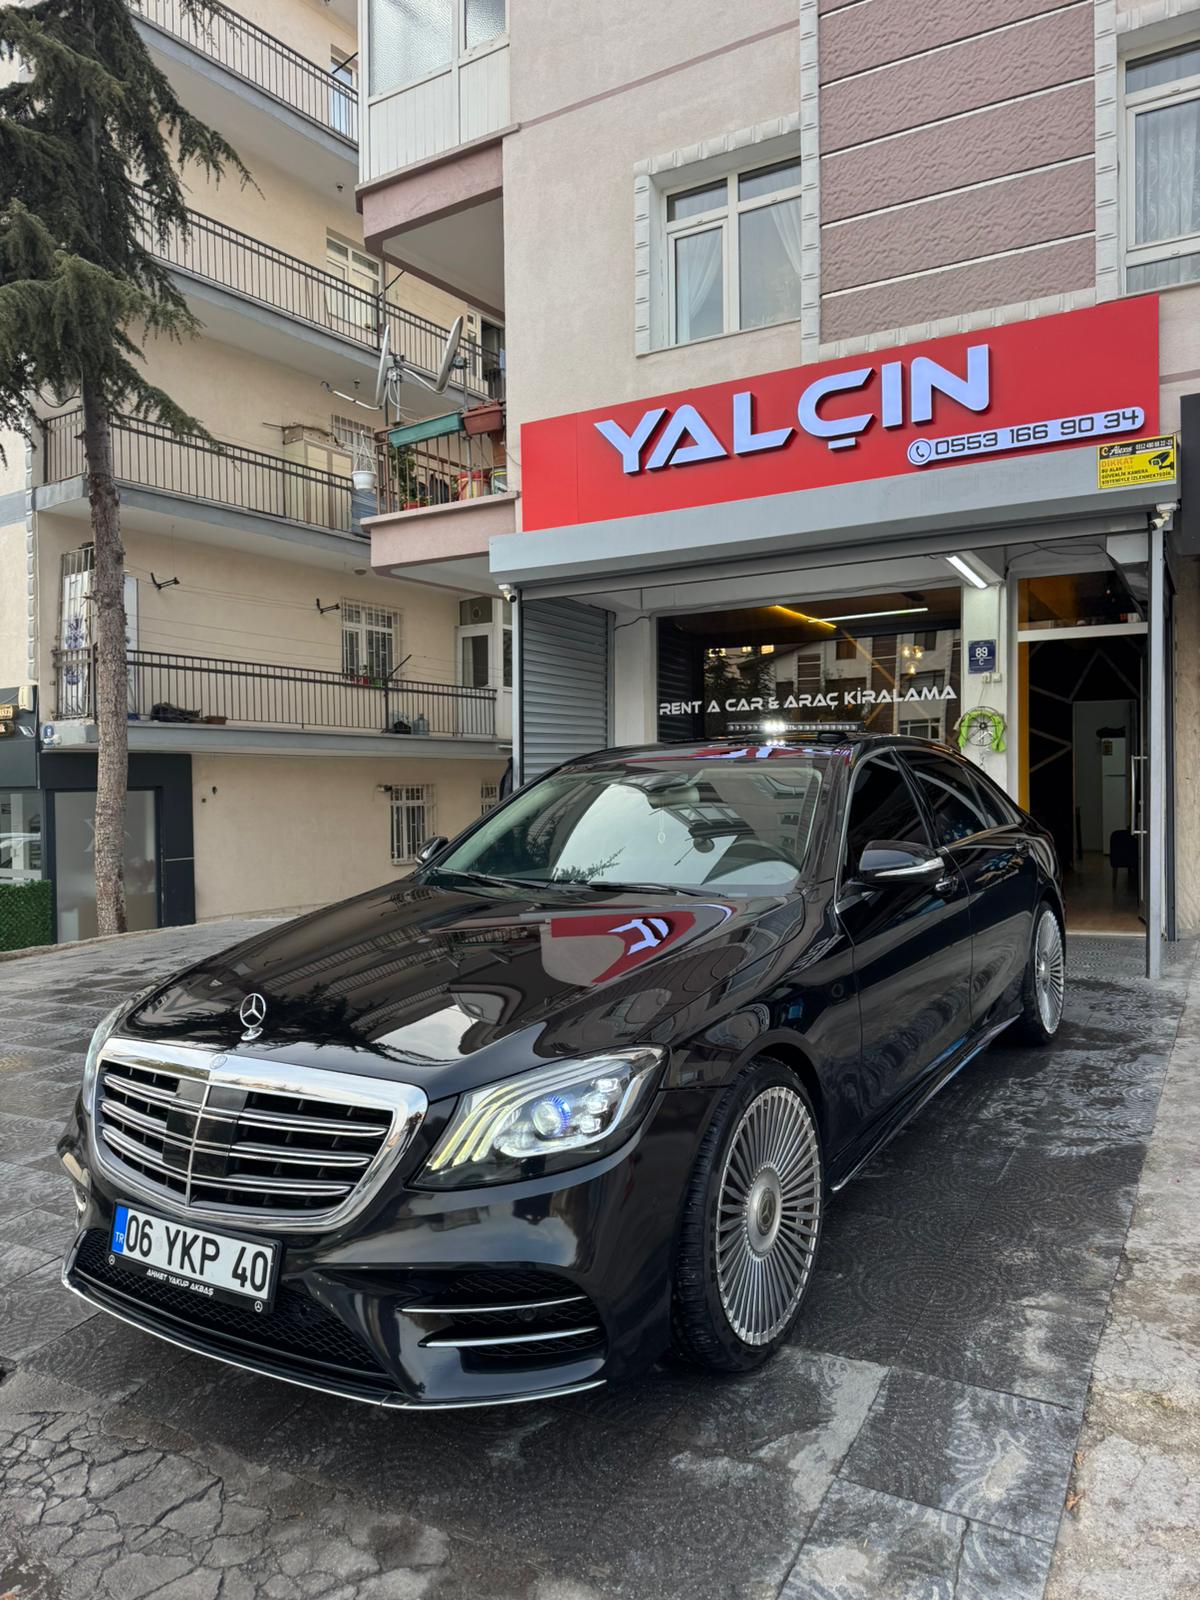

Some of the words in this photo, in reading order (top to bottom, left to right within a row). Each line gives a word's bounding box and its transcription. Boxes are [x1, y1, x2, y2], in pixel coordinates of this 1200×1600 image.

[593, 343, 990, 475] YALÇIN
[935, 432, 998, 456] 0553
[1009, 424, 1048, 443] 166
[1060, 416, 1094, 436] 90
[1104, 409, 1139, 429] 34
[975, 646, 988, 658] 89
[659, 700, 702, 716] RENT
[707, 699, 721, 713] A
[725, 696, 762, 712] CAR
[768, 696, 780, 710] &
[783, 691, 839, 711] ARAÇ
[844, 685, 957, 705] KİRALAMA
[115, 1231, 124, 1245] TR
[125, 1214, 154, 1258] 06
[165, 1225, 220, 1276] YKP
[231, 1246, 269, 1292] 40
[146, 1269, 168, 1281] AHMET
[168, 1275, 190, 1288] YAKUP
